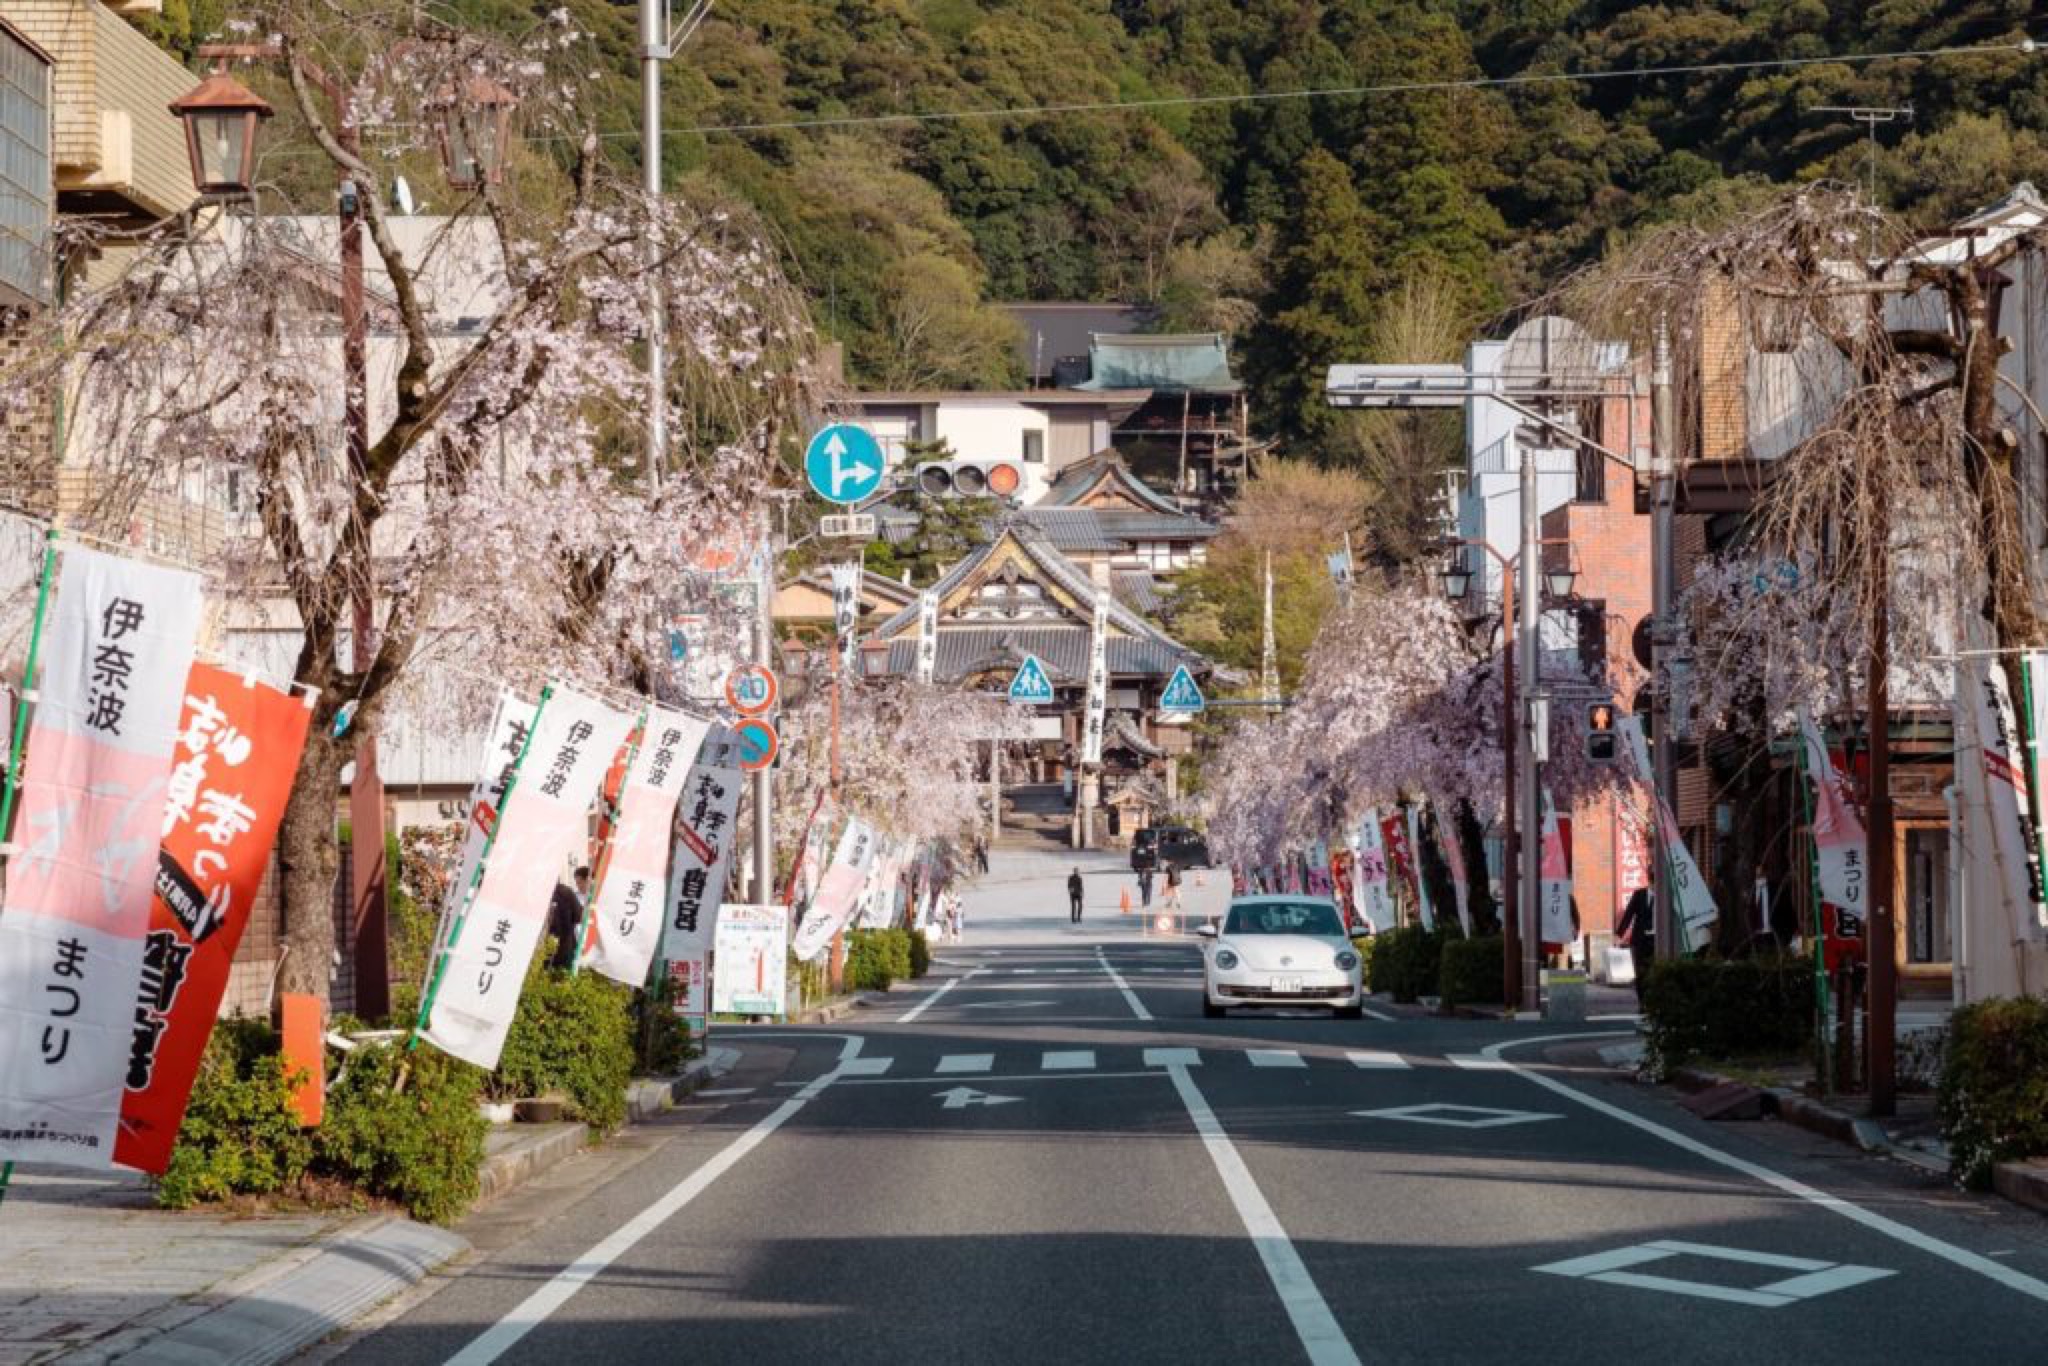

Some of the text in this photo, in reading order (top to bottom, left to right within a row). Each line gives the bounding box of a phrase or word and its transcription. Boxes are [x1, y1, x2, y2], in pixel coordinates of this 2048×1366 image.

[86, 596, 145, 736] 伊奈波
[541, 719, 593, 799] 伊奈波
[646, 727, 682, 788] 伊奈波
[619, 880, 646, 938] まつり
[1844, 848, 1863, 902] まつり
[478, 918, 512, 996] まつり
[41, 937, 89, 1065] まつり
